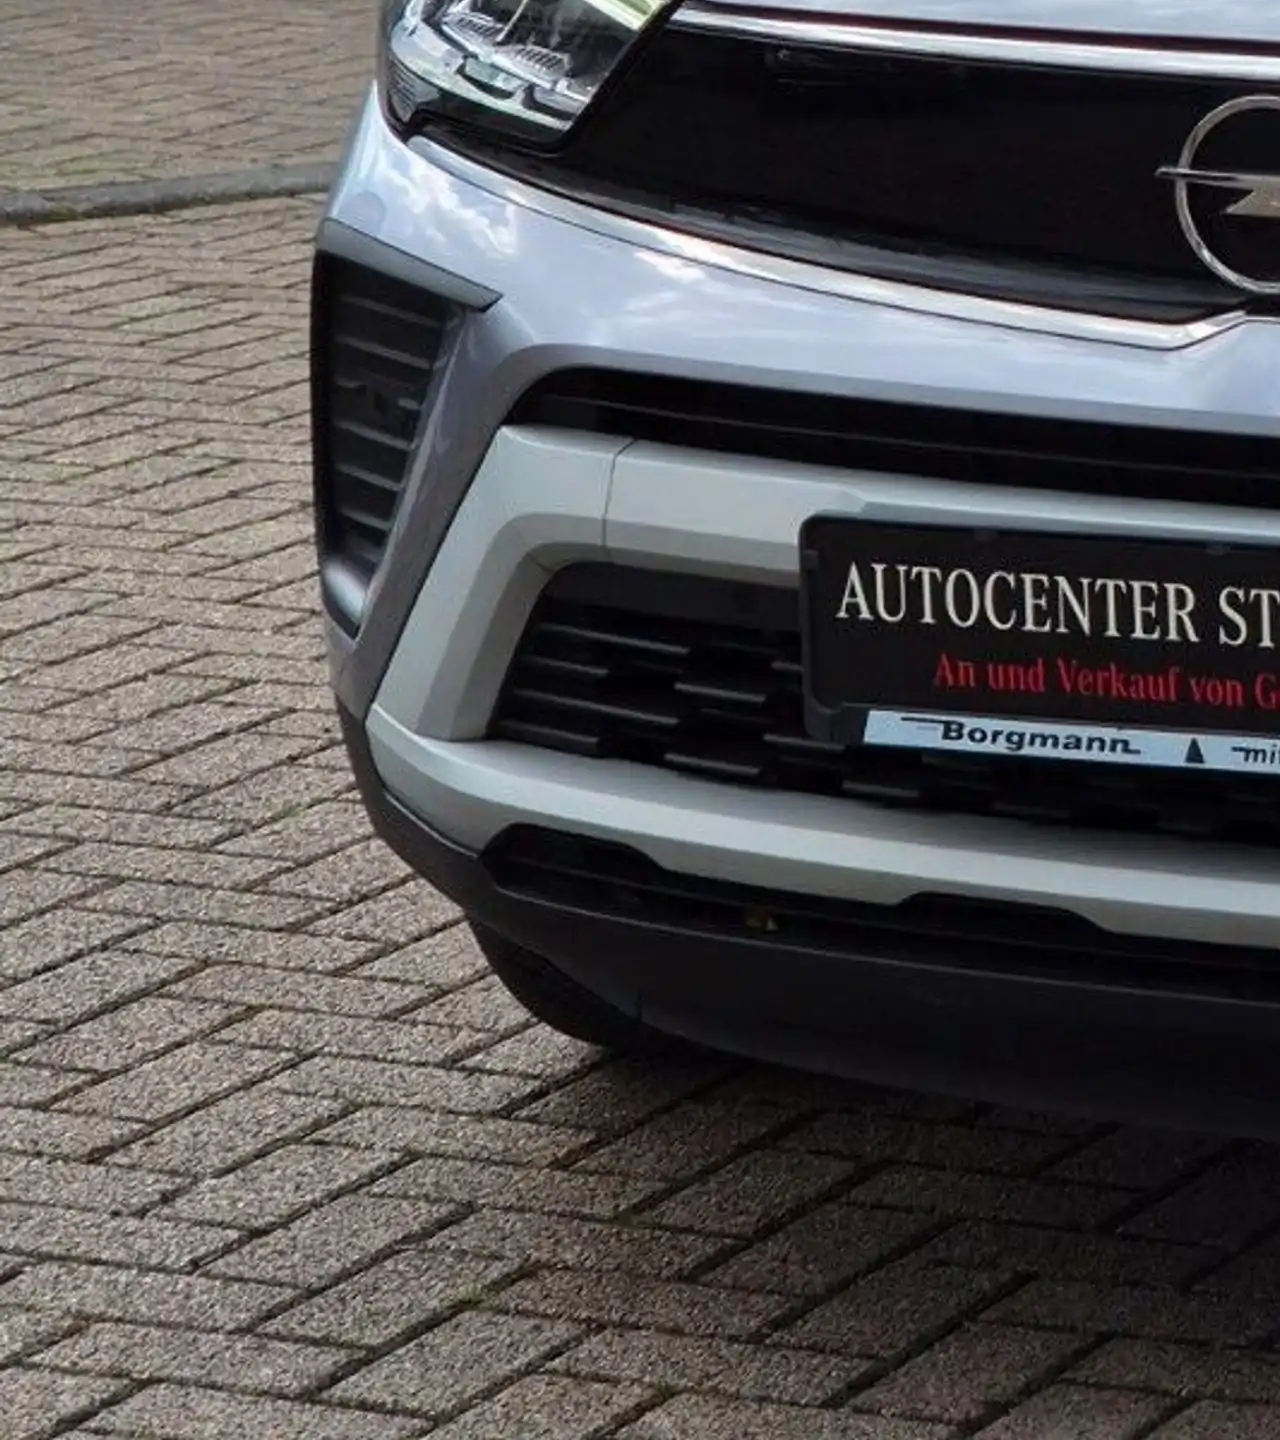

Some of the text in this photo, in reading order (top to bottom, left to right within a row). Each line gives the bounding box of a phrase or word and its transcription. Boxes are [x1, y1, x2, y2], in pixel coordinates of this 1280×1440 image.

[836, 561, 1200, 644] AUTOCENTER
[934, 653, 975, 688] An
[987, 659, 1046, 694] und
[1057, 659, 1180, 703] Verkauf
[1189, 674, 1245, 709] von
[928, 718, 1140, 755] Borgmann
